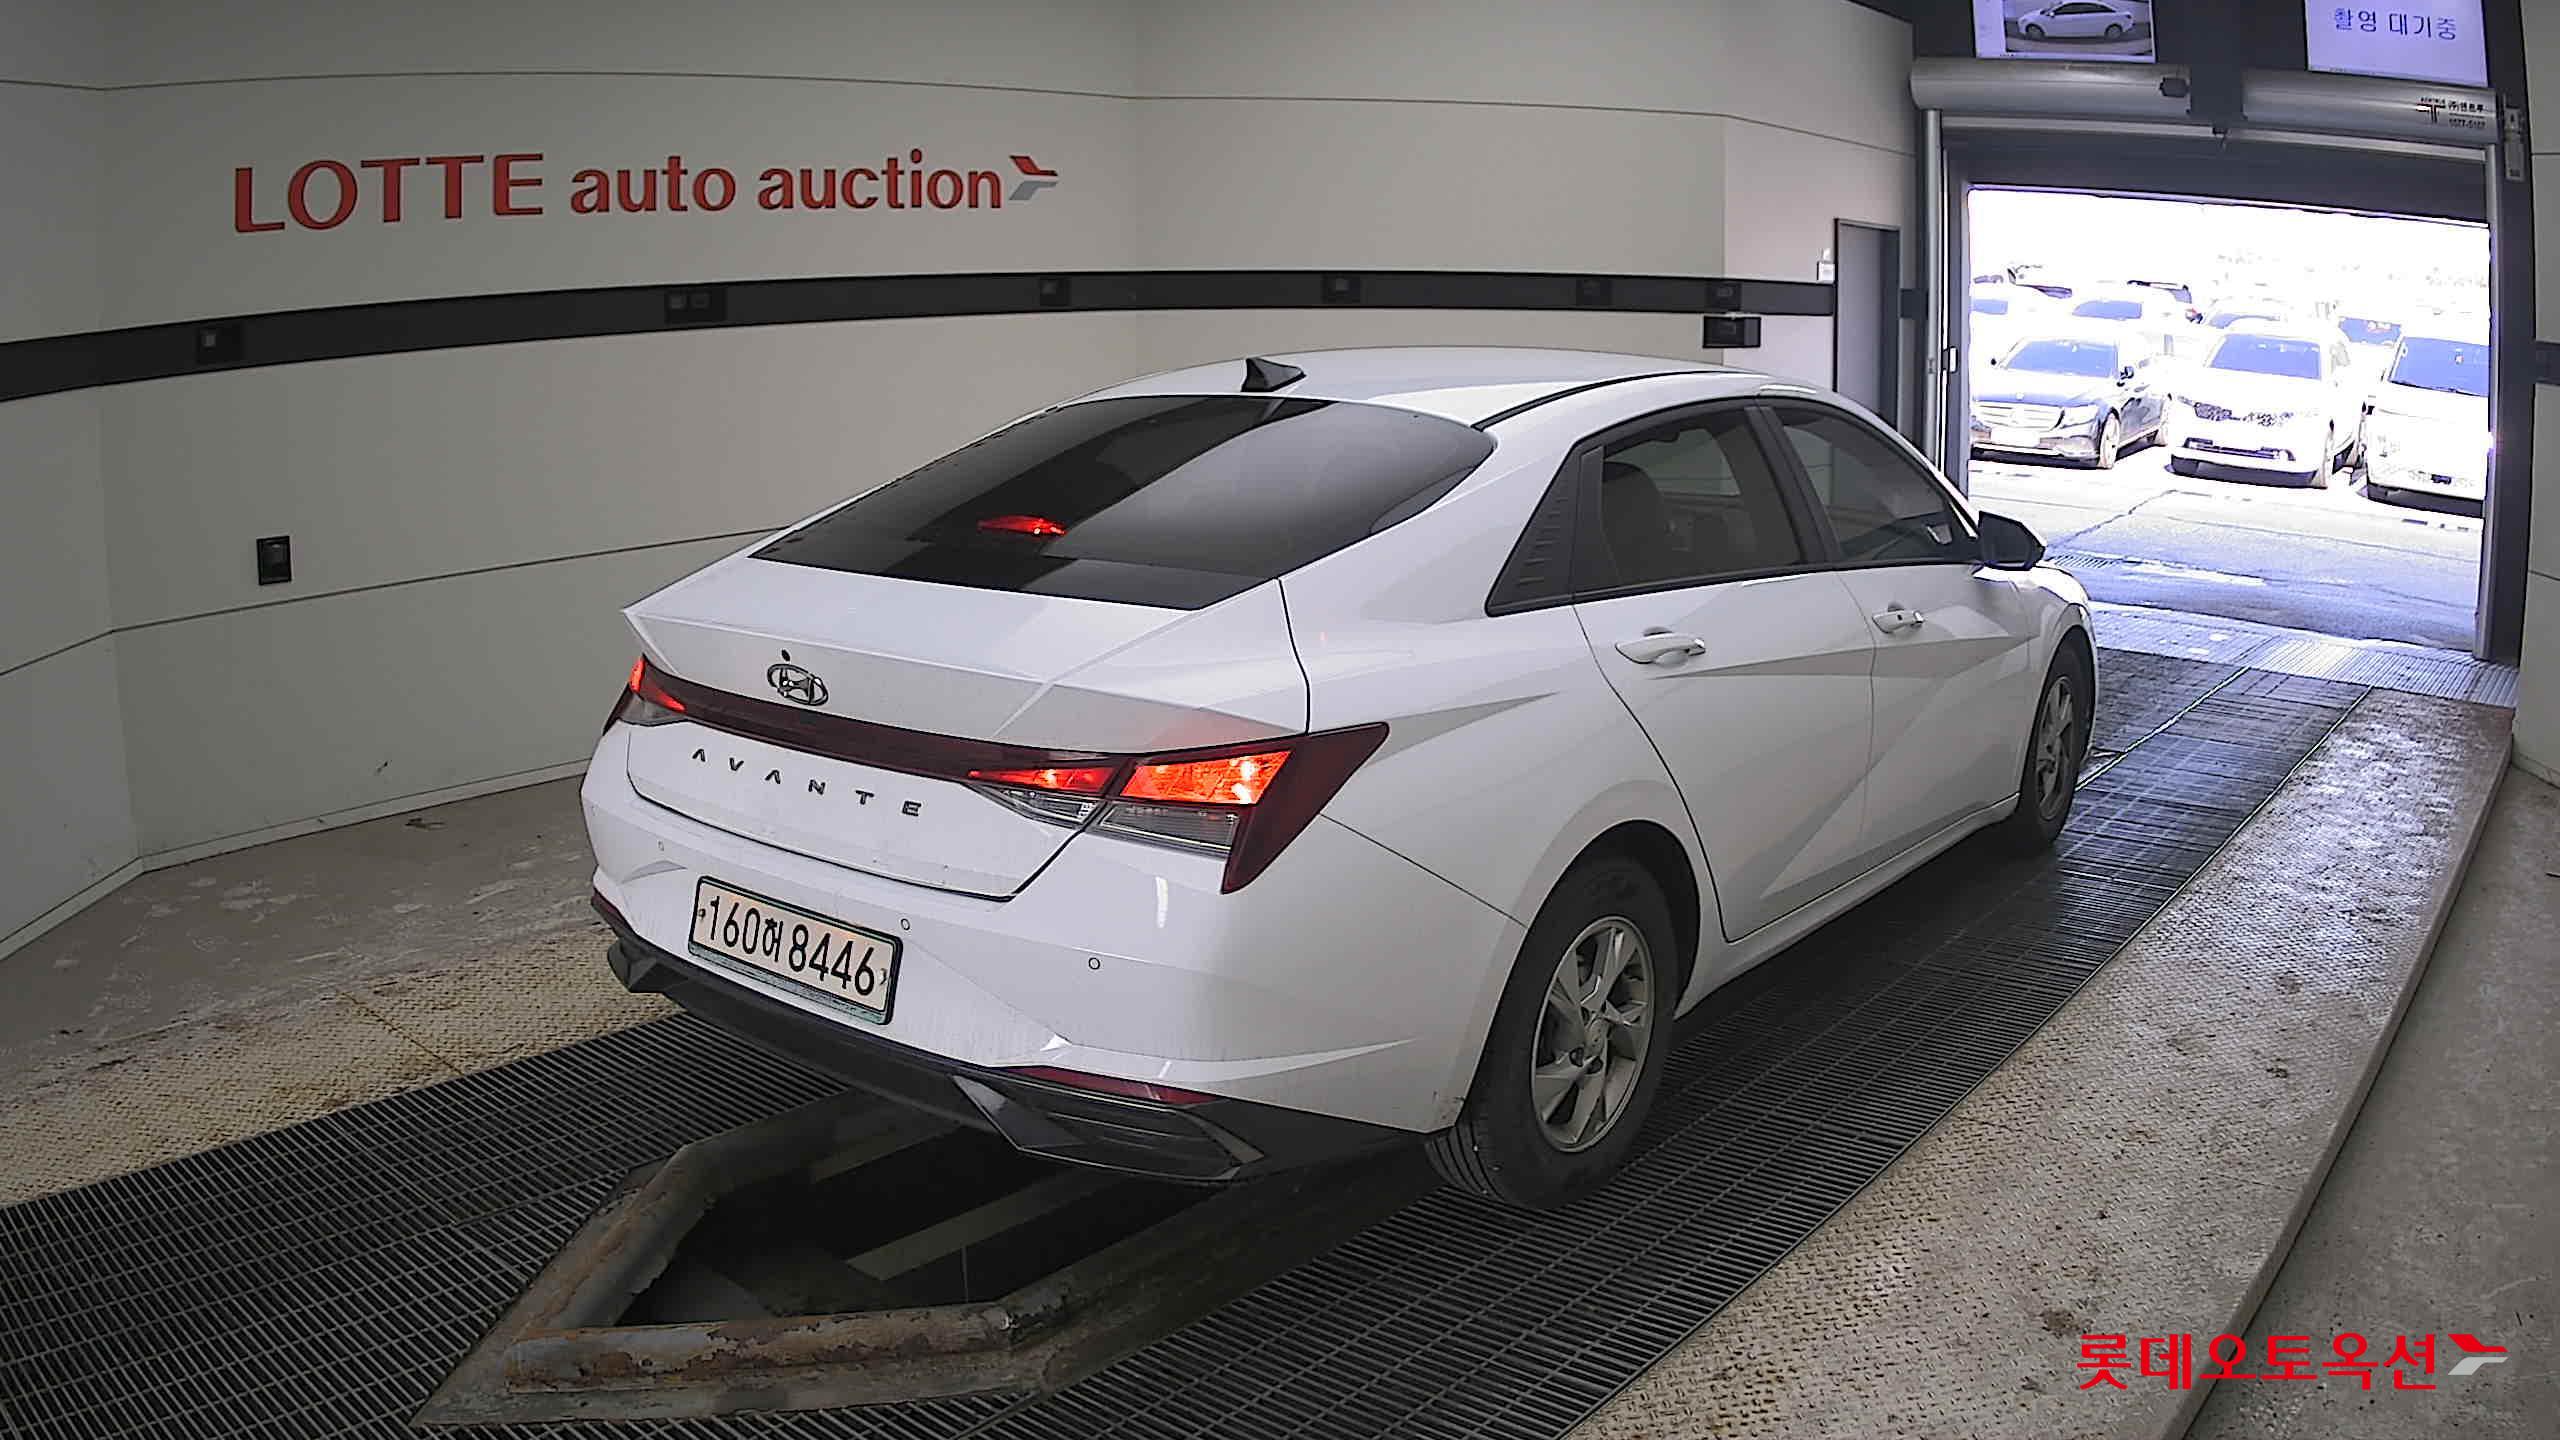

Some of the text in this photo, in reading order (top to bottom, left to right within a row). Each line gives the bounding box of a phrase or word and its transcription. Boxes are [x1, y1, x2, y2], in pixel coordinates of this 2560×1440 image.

[2388, 13, 2457, 41] 대기중
[235, 149, 1003, 232] LOTTE auto auction
[691, 747, 924, 818] AVANTE
